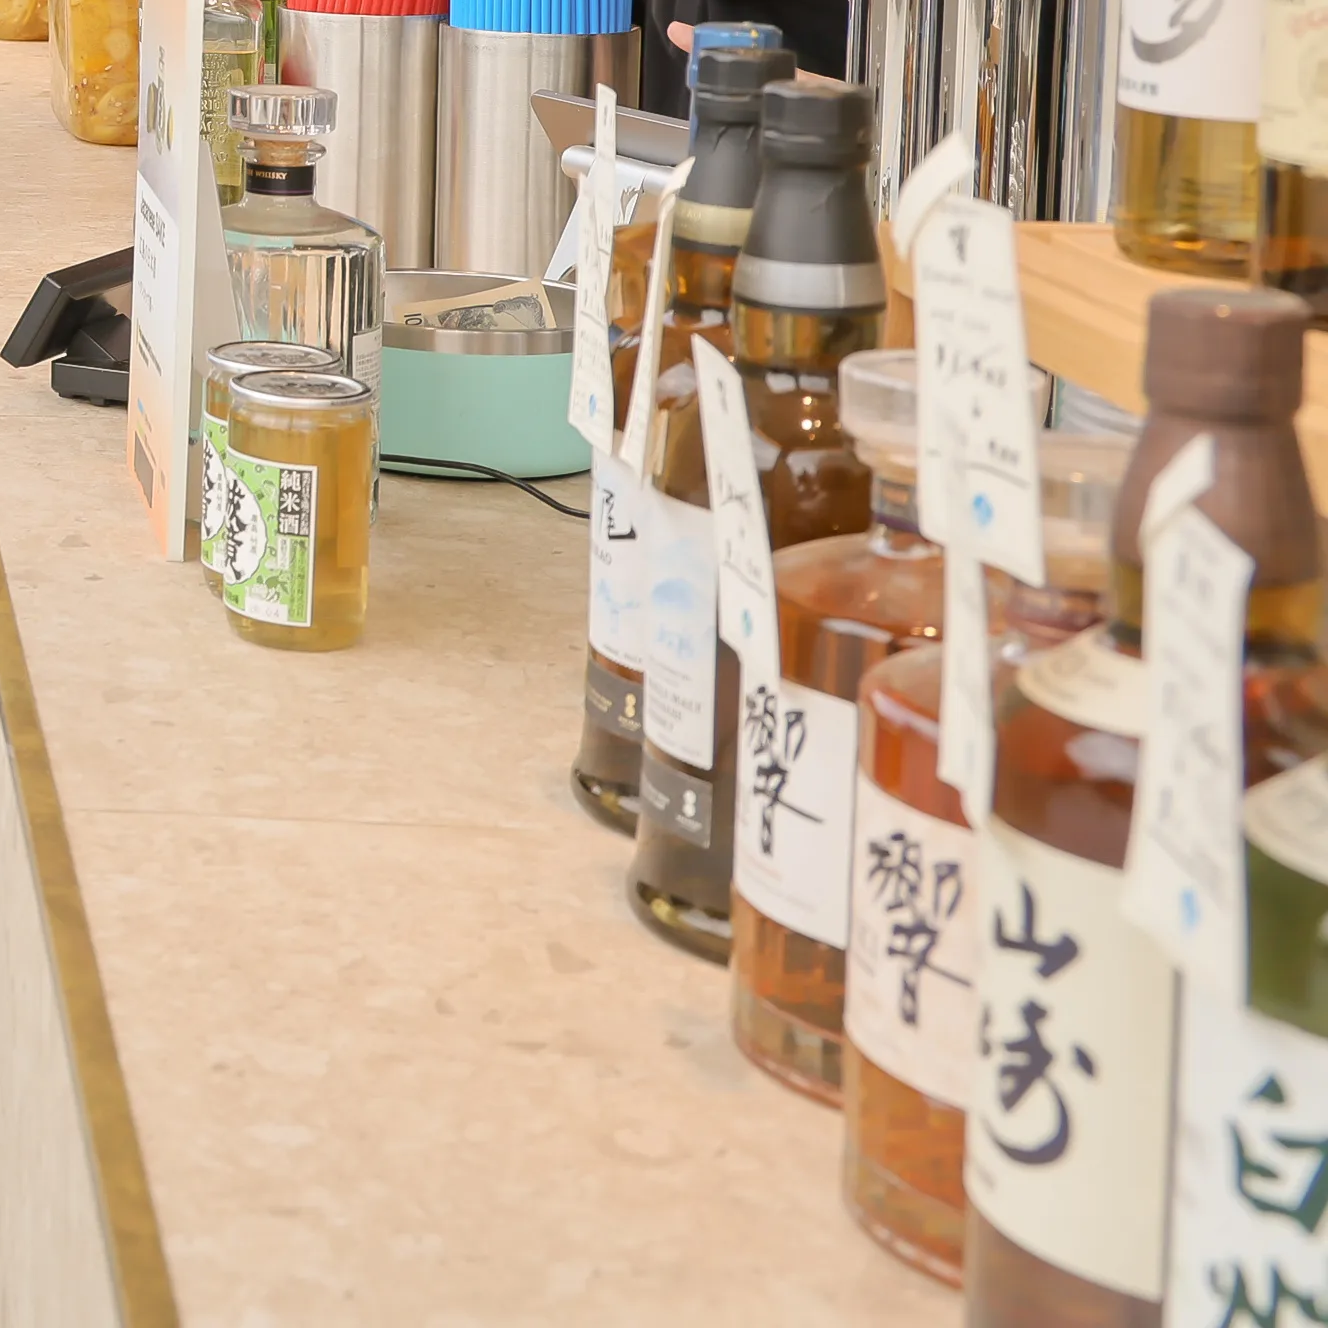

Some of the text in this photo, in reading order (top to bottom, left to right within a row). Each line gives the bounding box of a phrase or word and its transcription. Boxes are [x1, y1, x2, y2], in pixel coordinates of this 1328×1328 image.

[255, 170, 288, 180] WHISKY
[278, 470, 301, 535] 純米酒
[981, 878, 1097, 1167] 山崎
